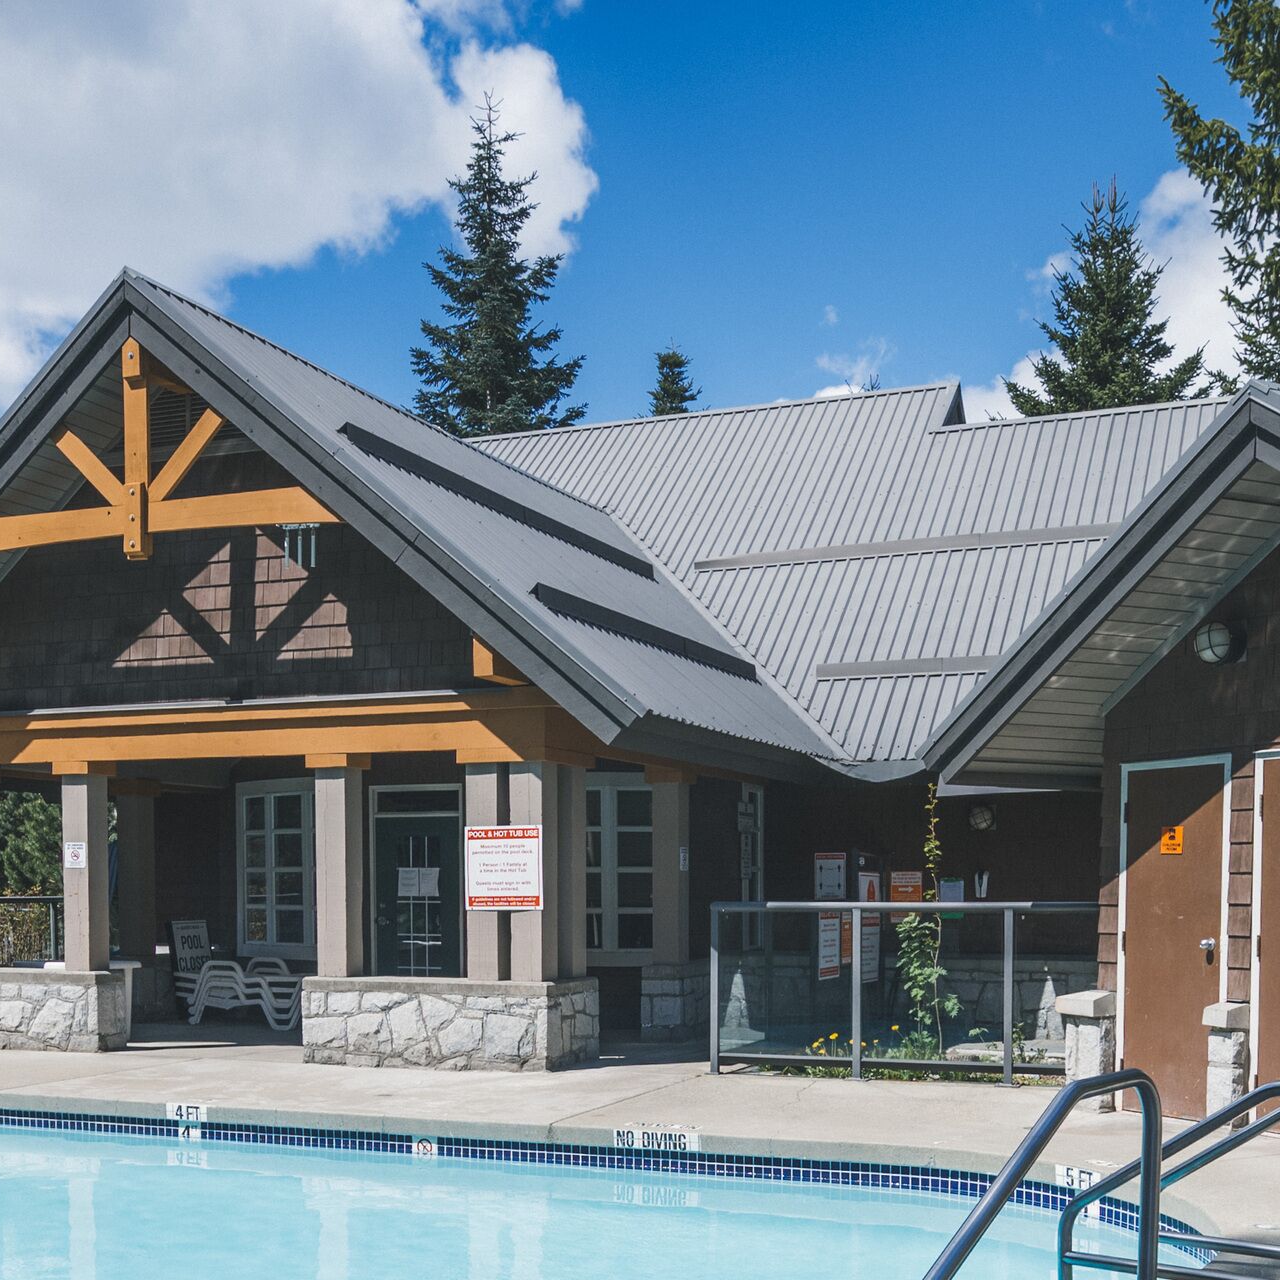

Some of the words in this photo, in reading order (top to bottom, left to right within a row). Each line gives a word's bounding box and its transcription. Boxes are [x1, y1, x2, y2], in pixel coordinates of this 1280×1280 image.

[487, 830, 493, 838] &
[524, 829, 538, 837] USE
[181, 935, 204, 950] POOL
[176, 1105, 183, 1119] 4
[186, 1106, 200, 1120] FT
[616, 1130, 634, 1147] NO
[642, 1131, 686, 1151] DIVING
[1066, 1167, 1074, 1187] 5
[1078, 1169, 1093, 1188] FT
